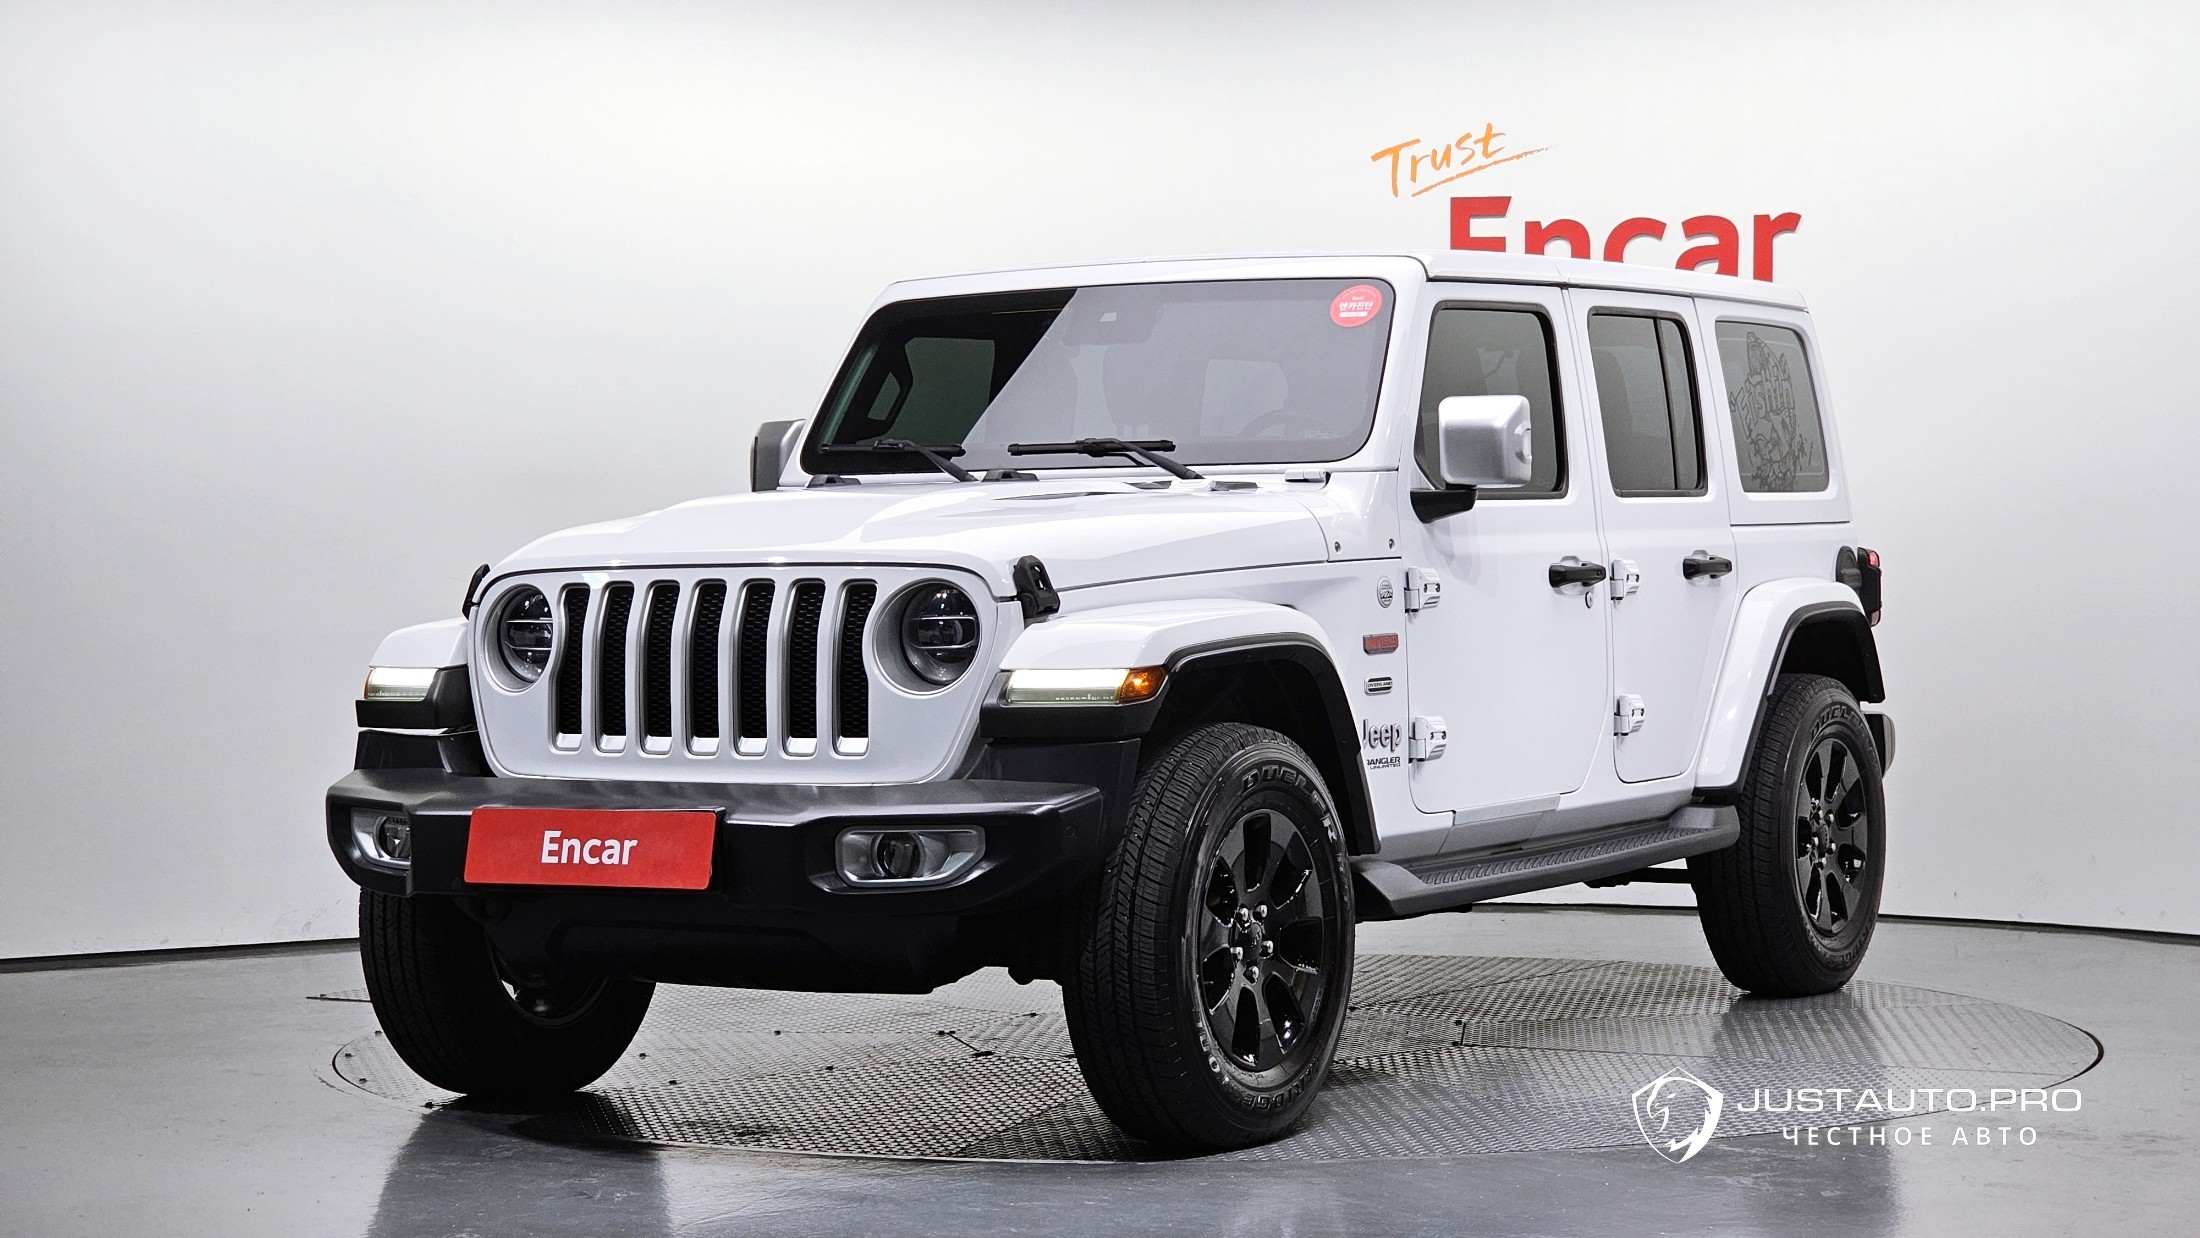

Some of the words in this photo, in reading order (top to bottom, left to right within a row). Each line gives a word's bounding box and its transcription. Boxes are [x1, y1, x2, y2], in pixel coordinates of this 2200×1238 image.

[1370, 122, 1507, 198] Trust
[1450, 196, 1802, 283] Encar
[1362, 719, 1402, 753] Jeep
[1366, 756, 1401, 766] RANGLER
[541, 830, 638, 865] Encar
